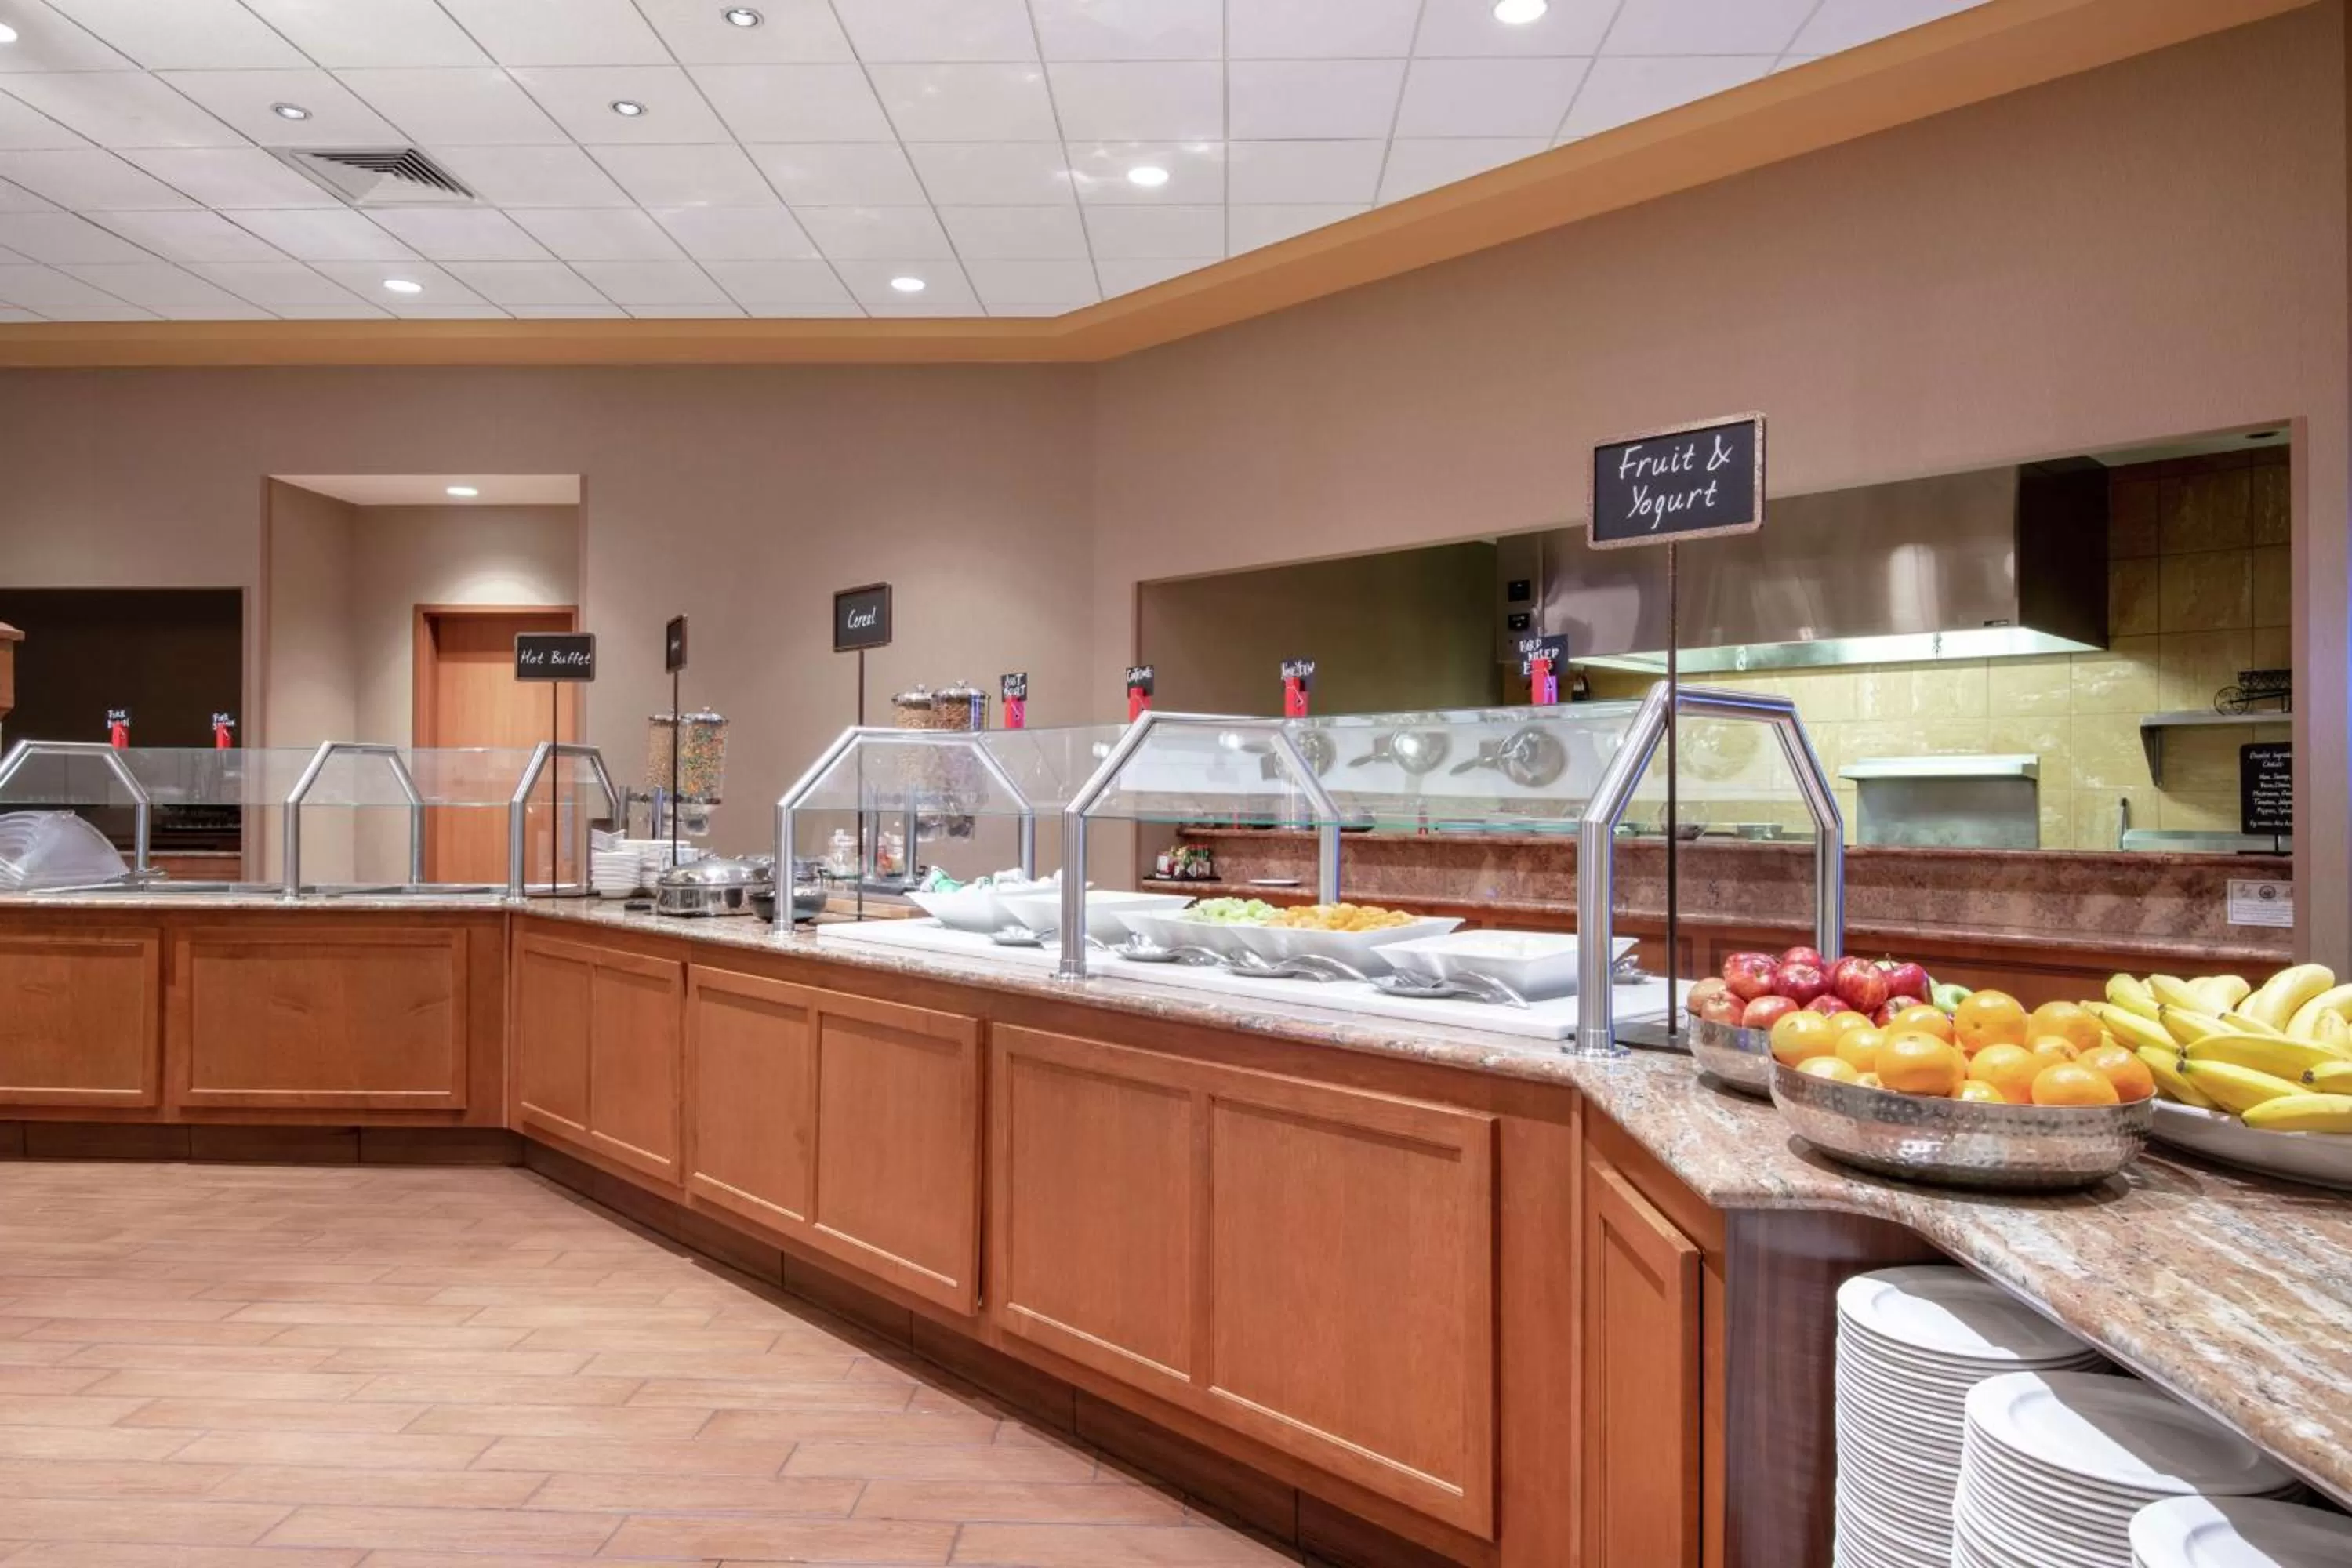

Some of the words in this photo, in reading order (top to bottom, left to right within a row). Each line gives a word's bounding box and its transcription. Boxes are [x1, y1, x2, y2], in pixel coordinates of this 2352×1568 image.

[1619, 443, 1696, 480] Fruit
[1706, 434, 1733, 471] &
[1625, 479, 1719, 530] Yogurt
[848, 605, 877, 629] Cereal
[520, 647, 544, 664] Hot
[551, 650, 590, 665] Buffet
